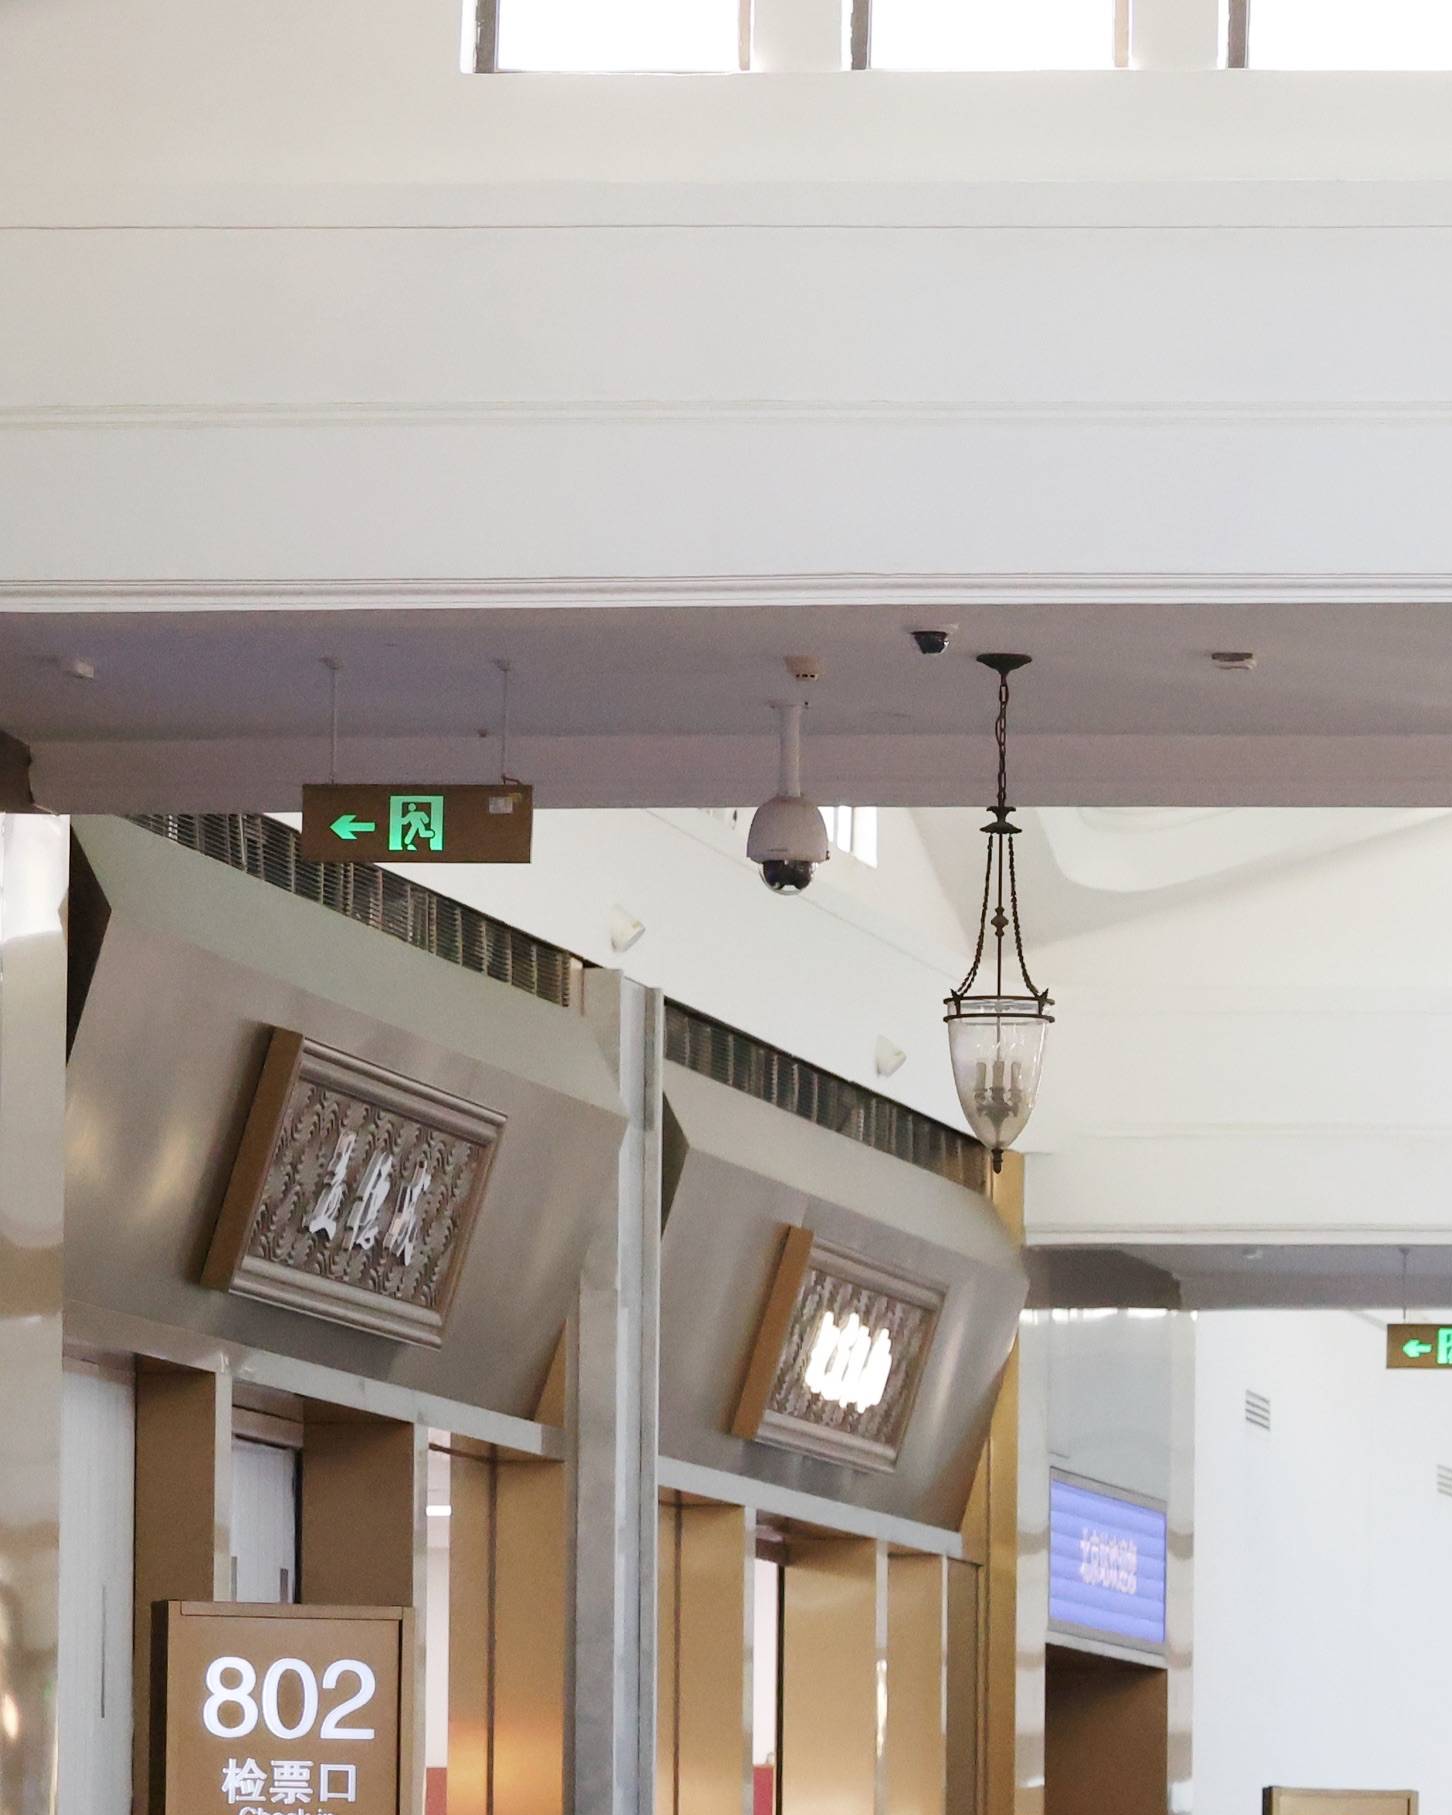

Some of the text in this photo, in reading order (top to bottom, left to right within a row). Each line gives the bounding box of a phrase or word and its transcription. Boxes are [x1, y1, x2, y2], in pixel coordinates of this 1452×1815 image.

[203, 1656, 376, 1740] 802
[221, 1758, 357, 1804] 检票口
